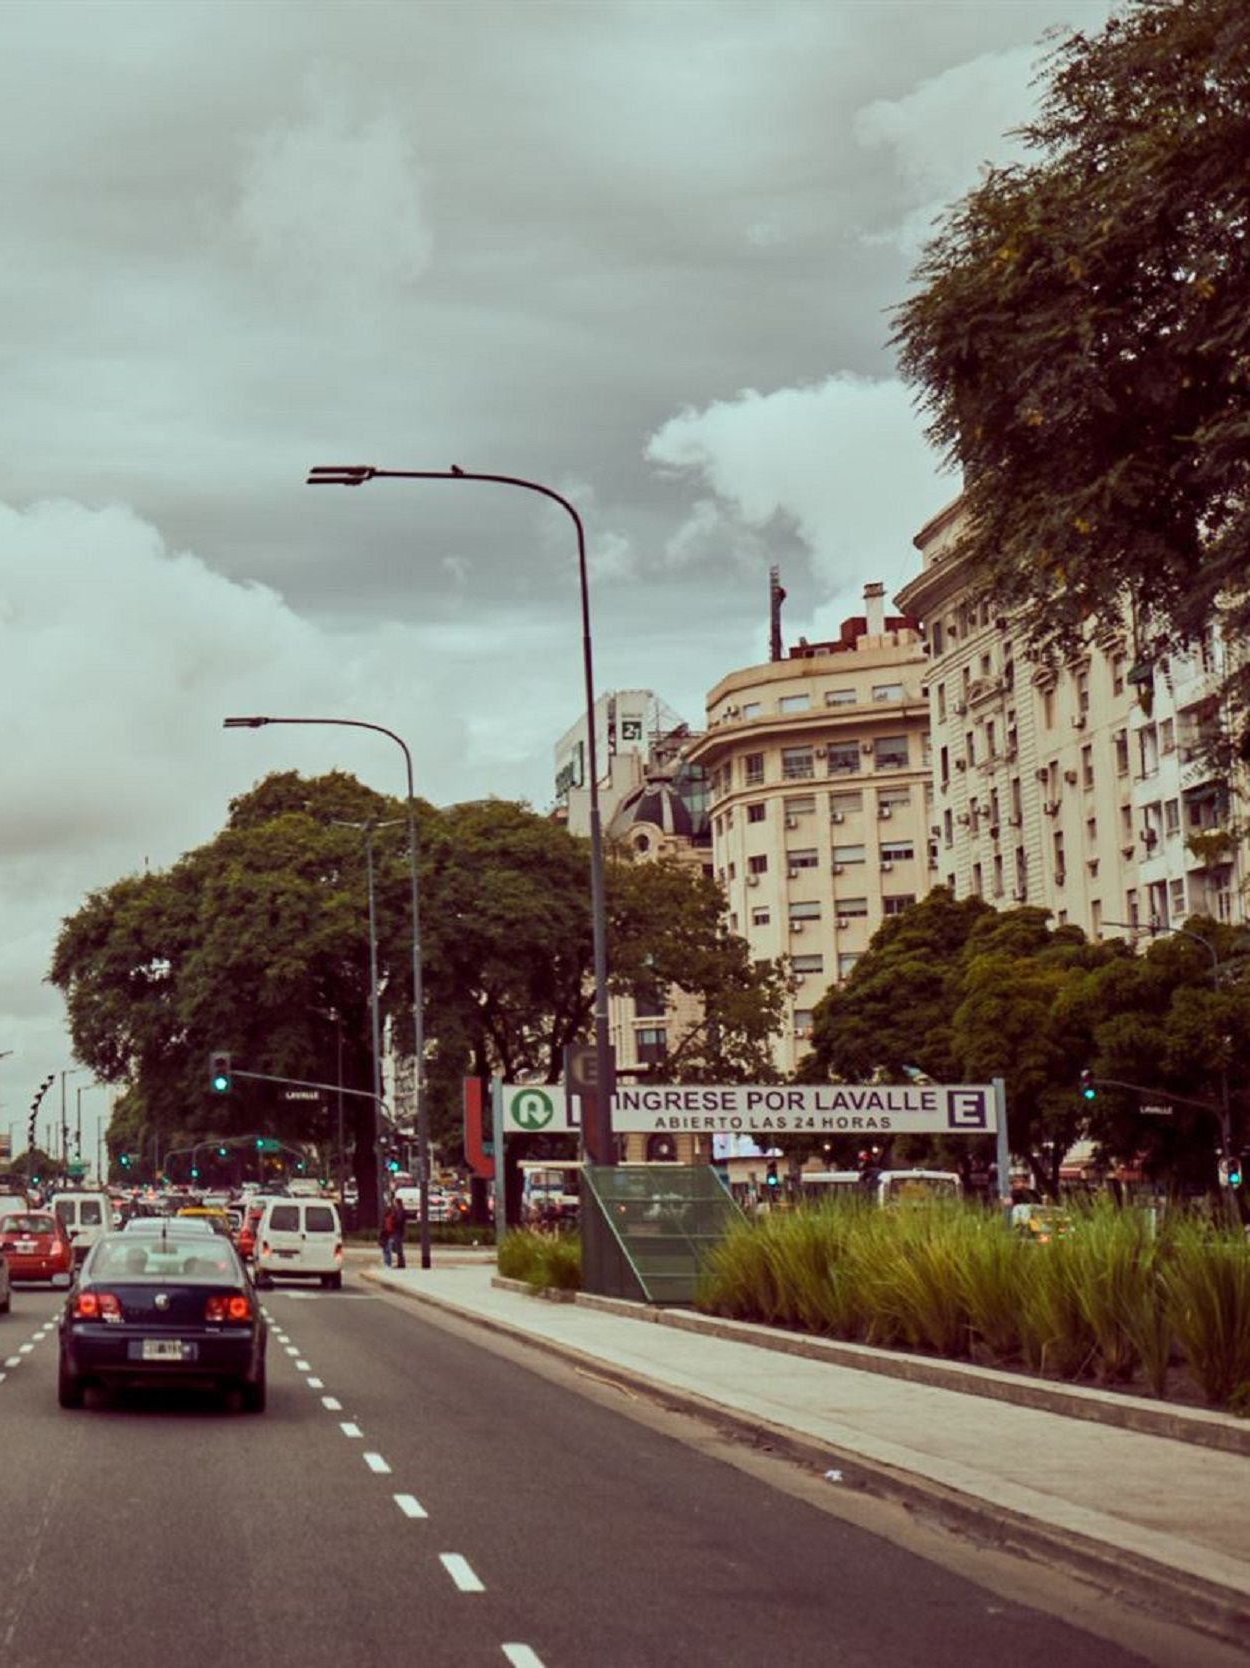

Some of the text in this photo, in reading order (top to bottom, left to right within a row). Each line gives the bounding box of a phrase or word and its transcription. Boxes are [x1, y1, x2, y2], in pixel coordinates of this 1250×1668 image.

[615, 1090, 938, 1111] INGRESE POR LAVALLE
[952, 1092, 981, 1124] E
[654, 1116, 892, 1129] ABIERTO LAS 24 HORAS
